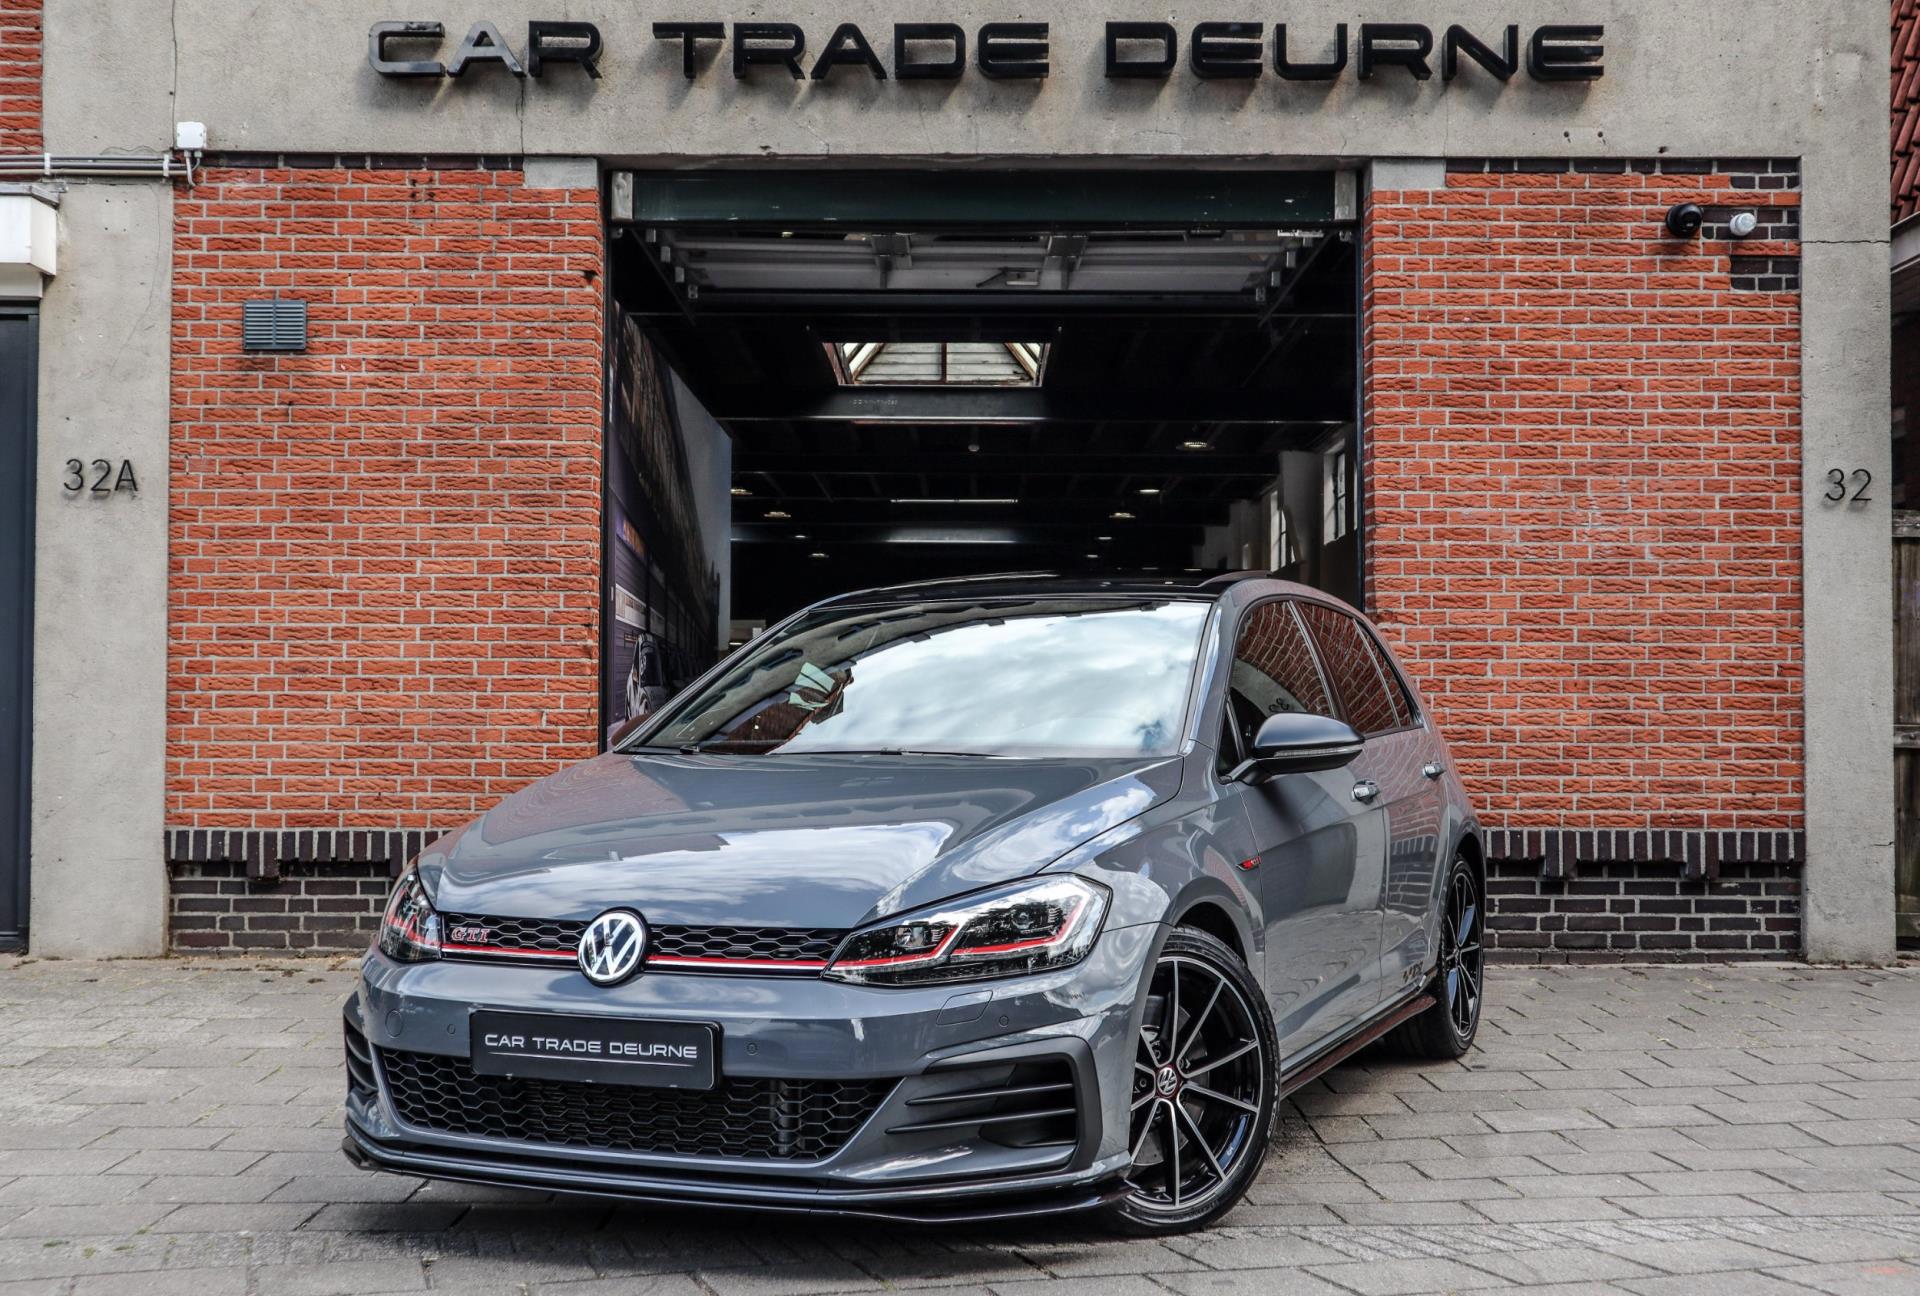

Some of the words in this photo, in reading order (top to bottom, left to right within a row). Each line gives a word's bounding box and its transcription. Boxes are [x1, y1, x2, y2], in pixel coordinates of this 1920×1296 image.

[368, 20, 602, 79] CAR
[652, 22, 1050, 80] TRADE
[1105, 21, 1604, 81] DEURNE
[63, 458, 138, 491] 32A
[1825, 468, 1872, 501] 32
[451, 927, 490, 943] GTI
[484, 1033, 524, 1048] CAR
[532, 1037, 602, 1053] TRADE
[609, 1041, 697, 1059] DEURNE
